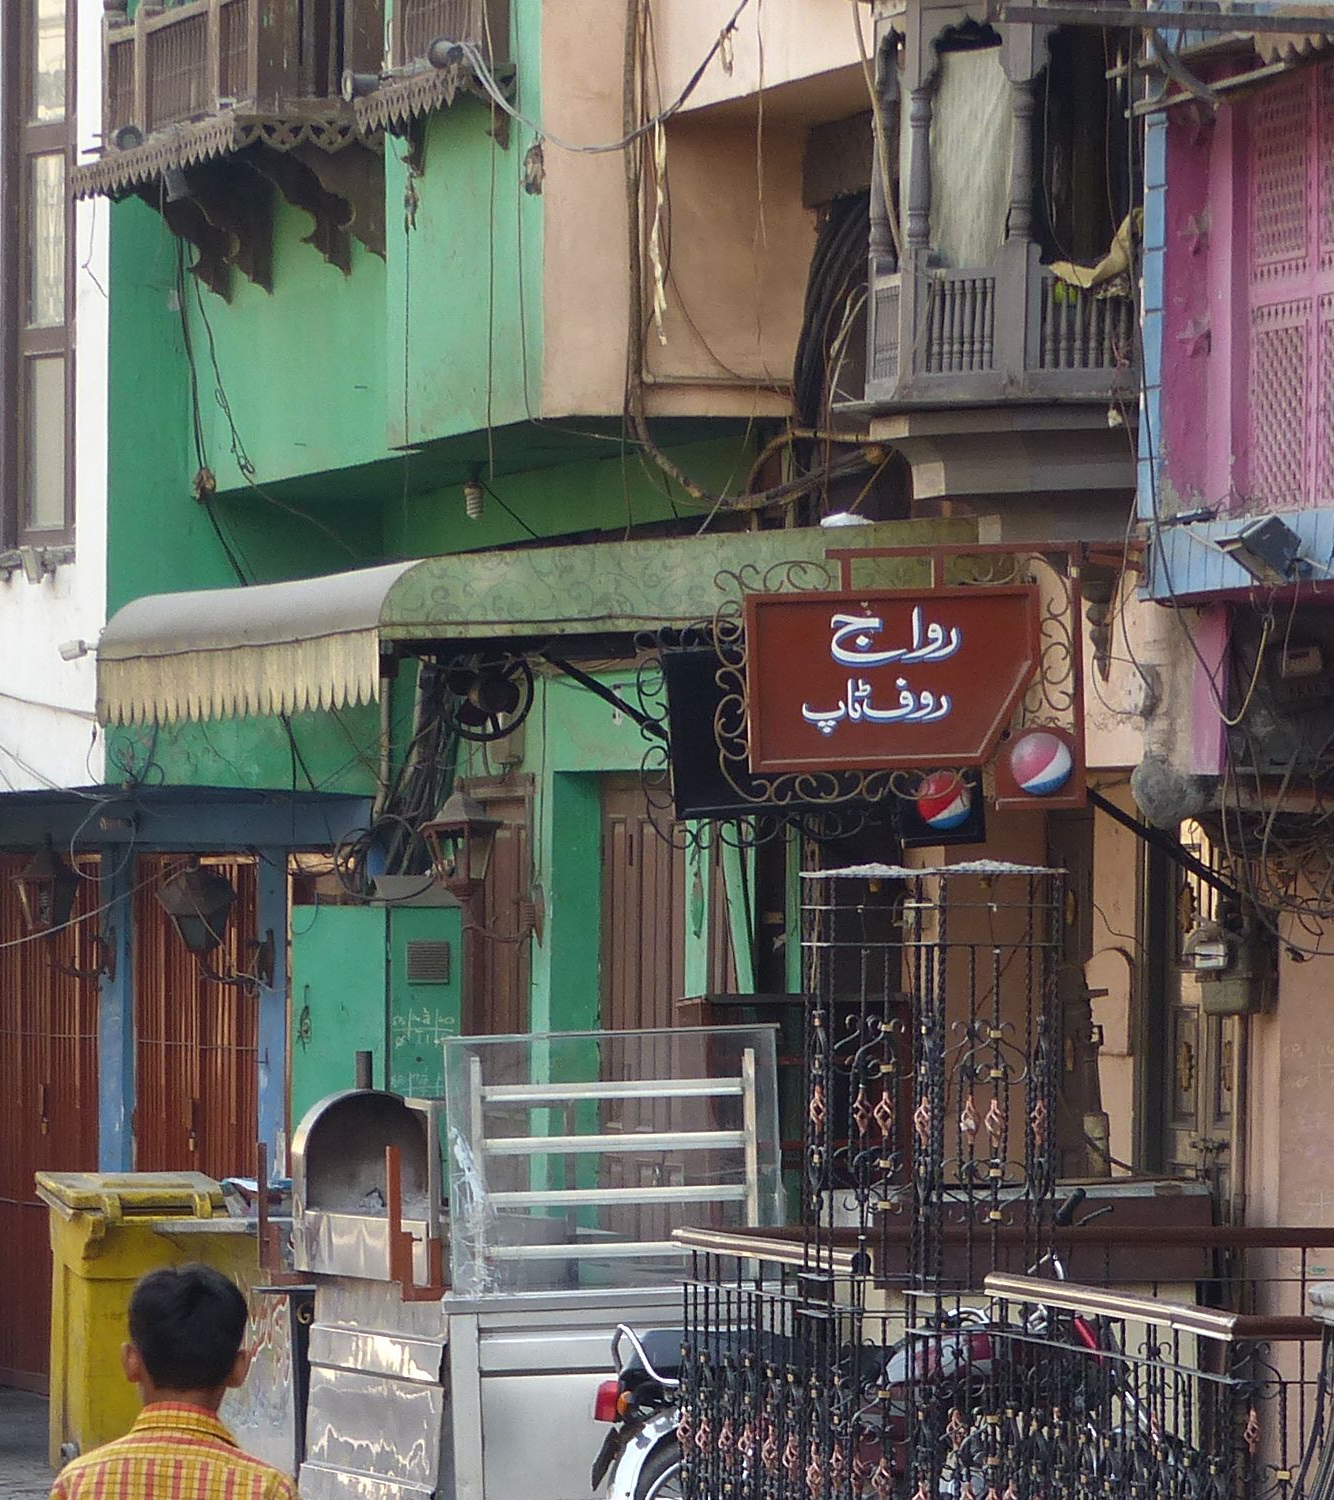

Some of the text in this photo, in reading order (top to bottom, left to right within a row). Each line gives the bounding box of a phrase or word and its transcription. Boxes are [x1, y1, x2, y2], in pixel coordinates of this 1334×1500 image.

[830, 605, 961, 667] رواج
[801, 677, 950, 735] روف ٹاپ
